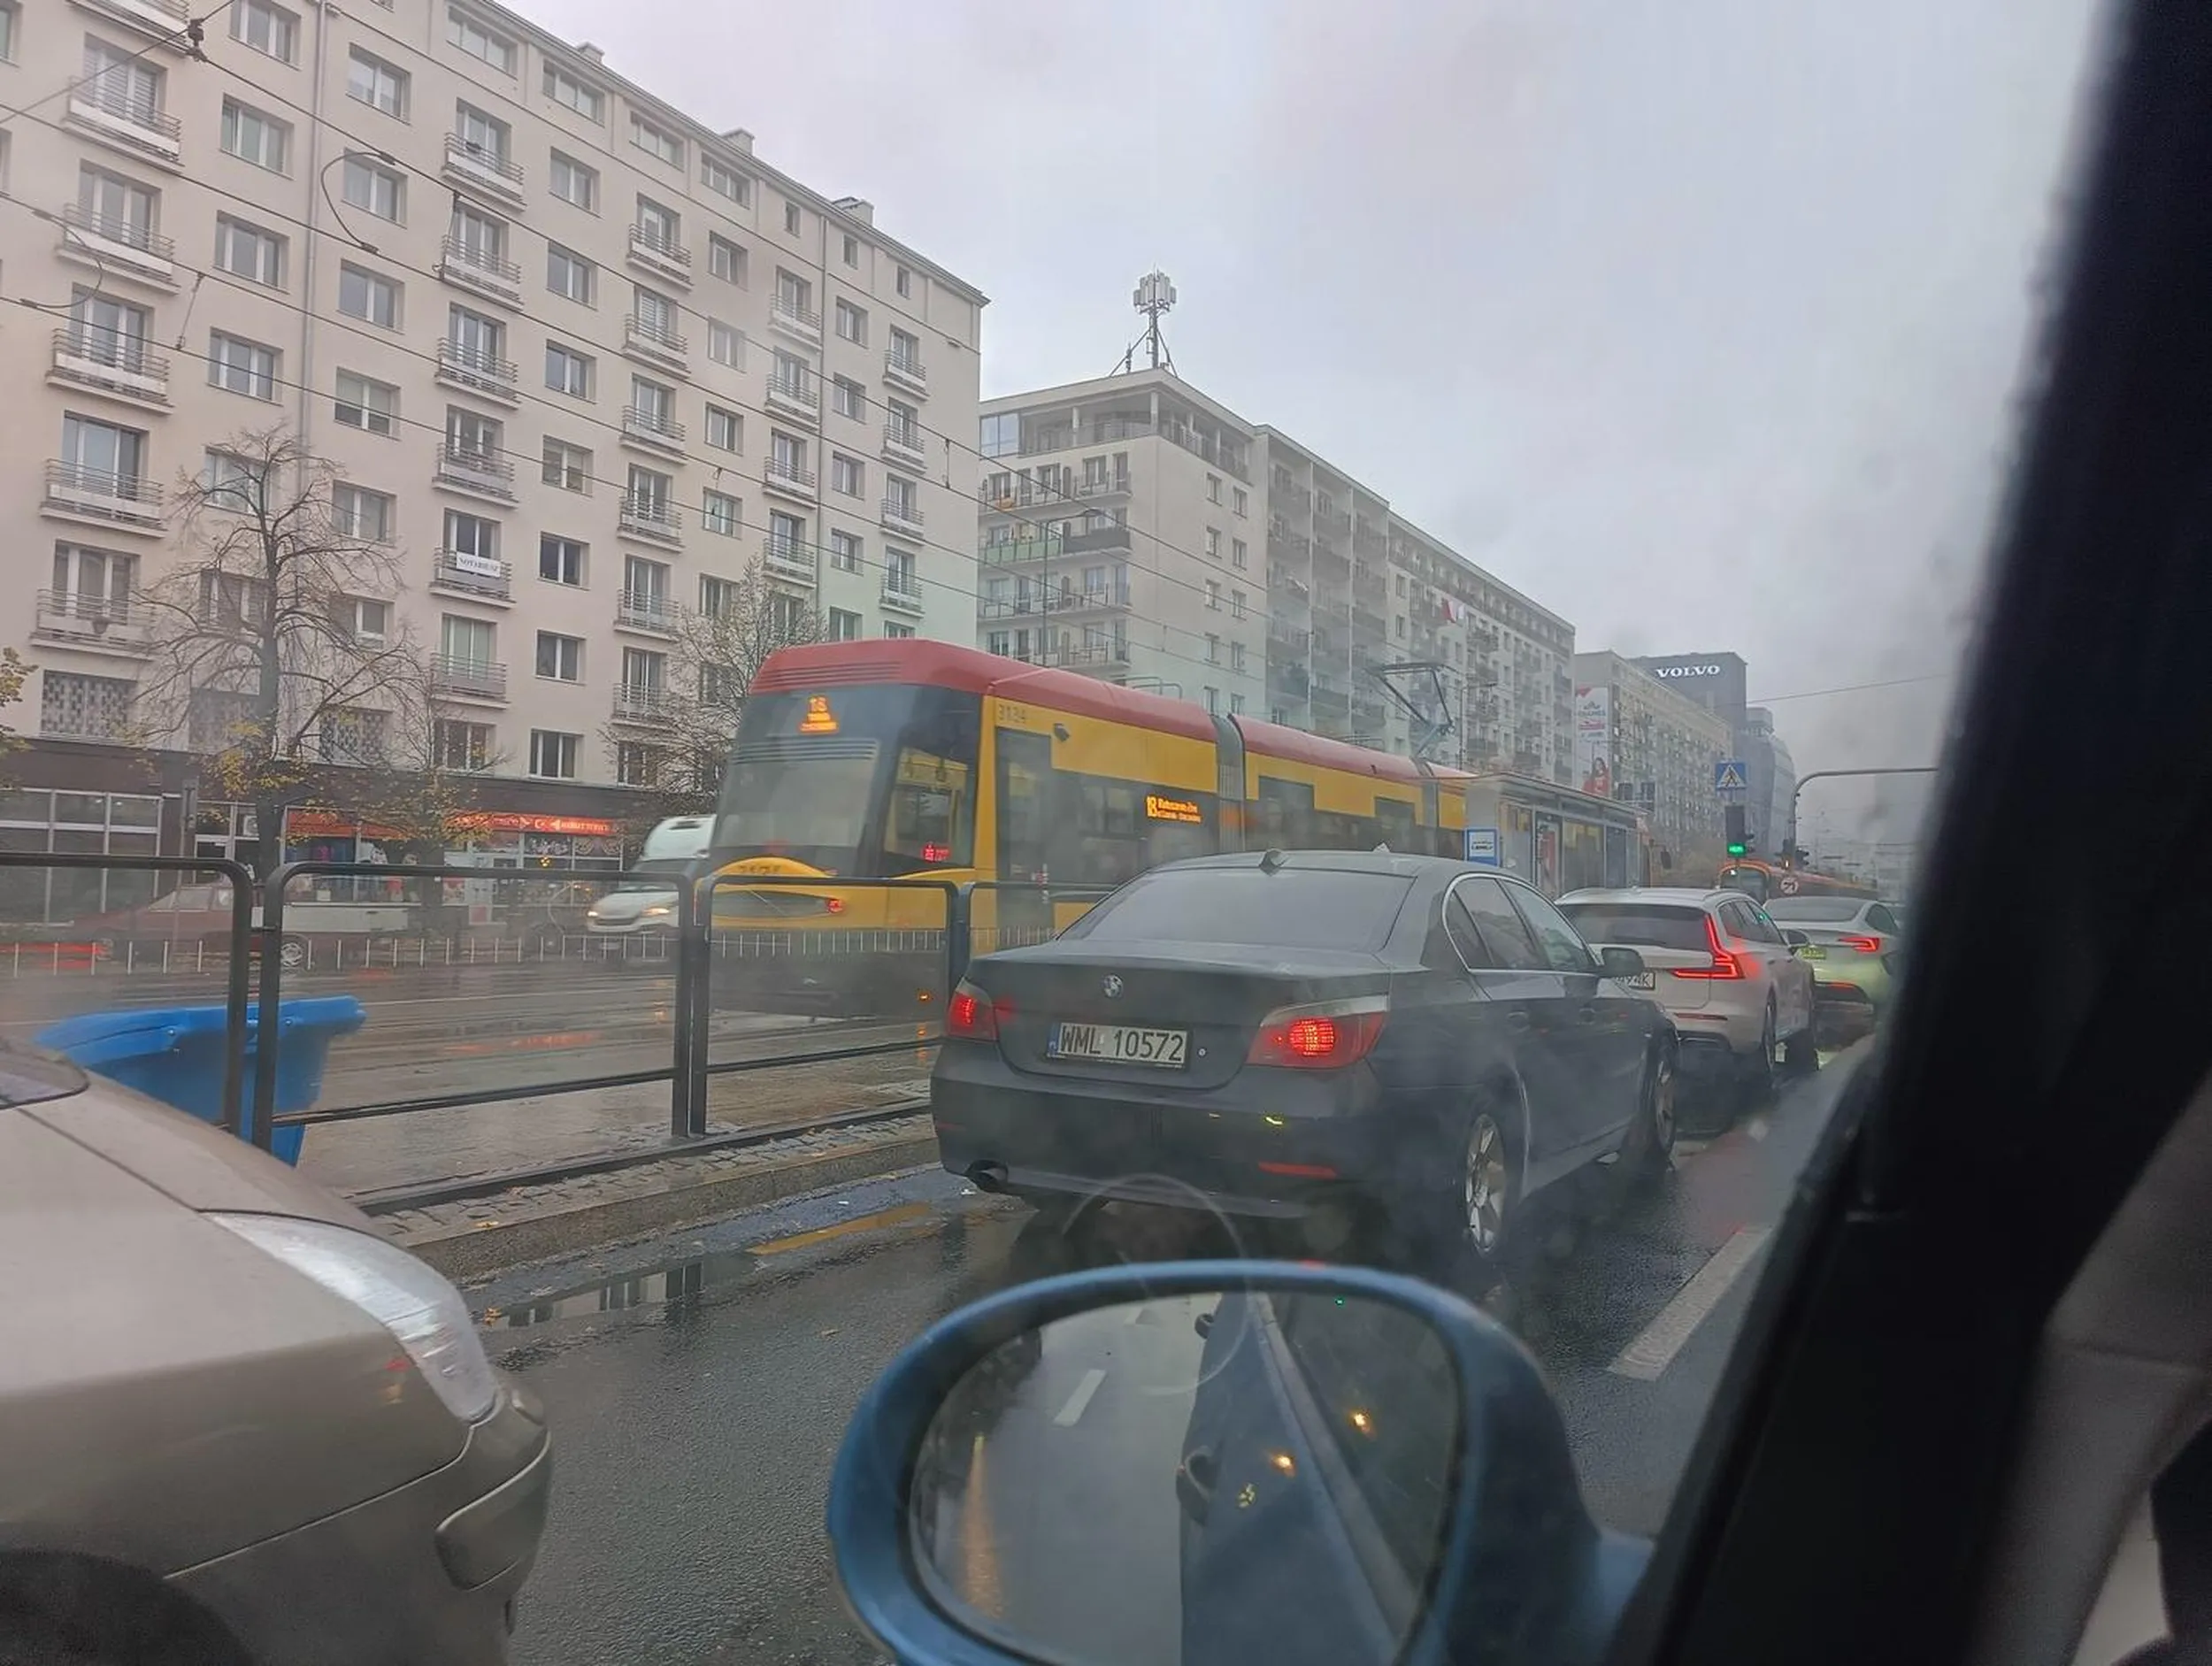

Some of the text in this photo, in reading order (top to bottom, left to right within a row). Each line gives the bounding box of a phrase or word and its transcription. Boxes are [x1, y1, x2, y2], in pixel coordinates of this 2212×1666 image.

[1656, 664, 1721, 678] VOLVO
[1061, 1025, 1184, 1062] WML 10572
